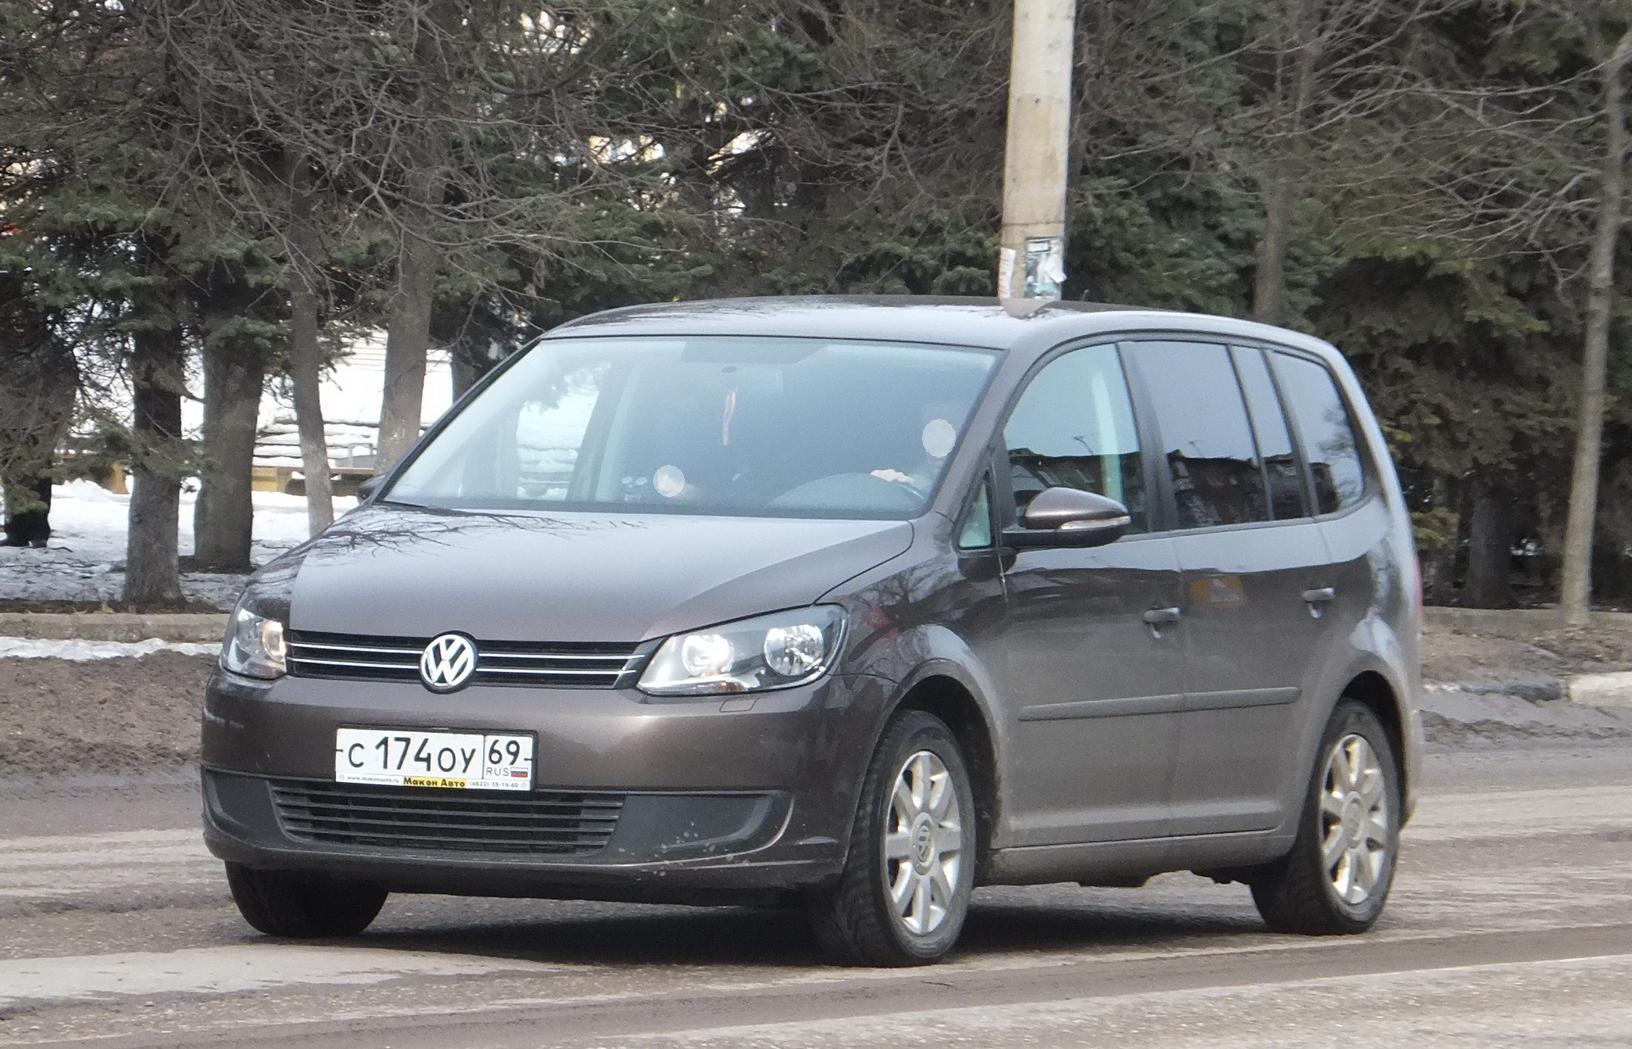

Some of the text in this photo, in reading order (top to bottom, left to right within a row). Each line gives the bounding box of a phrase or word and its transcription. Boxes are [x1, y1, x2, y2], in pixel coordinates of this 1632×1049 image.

[348, 737, 520, 774] С174ОУ 69
[486, 767, 510, 776] RUS
[403, 776, 465, 788] Макон Авто
